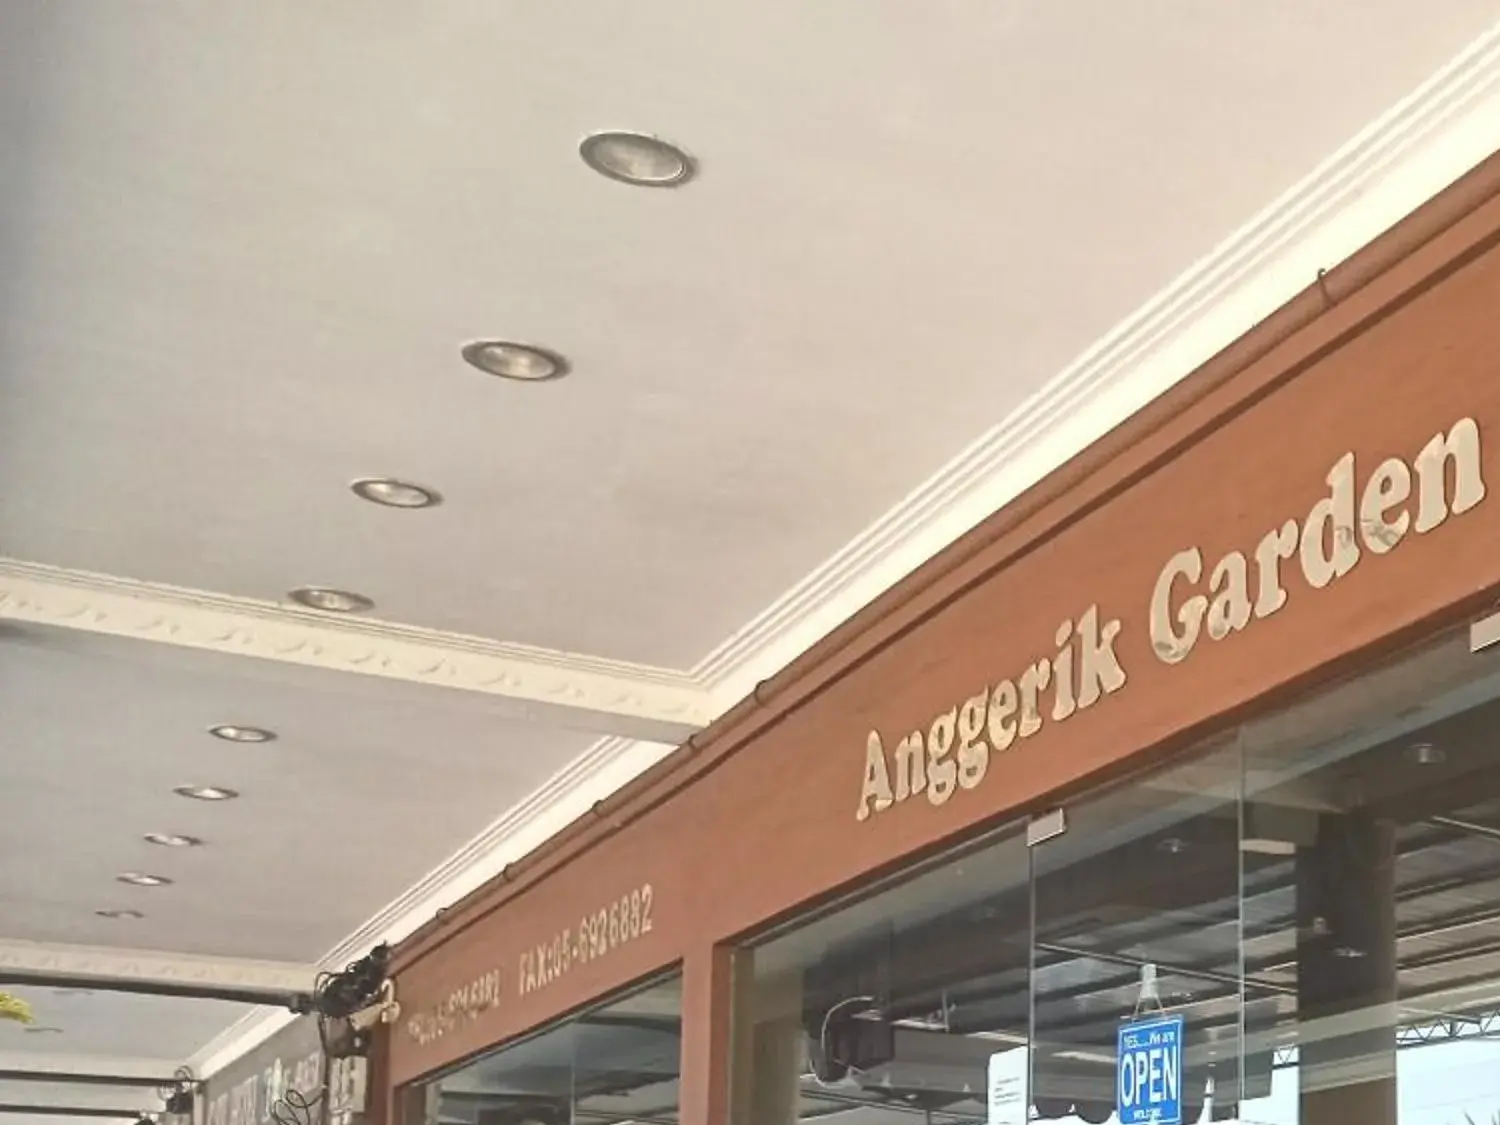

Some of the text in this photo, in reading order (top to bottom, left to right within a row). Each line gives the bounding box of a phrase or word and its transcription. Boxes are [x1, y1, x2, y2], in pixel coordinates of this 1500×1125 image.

[855, 603, 1127, 822] Anggerik
[1149, 416, 1487, 665] Garden
[1121, 1044, 1177, 1107] OPEN
